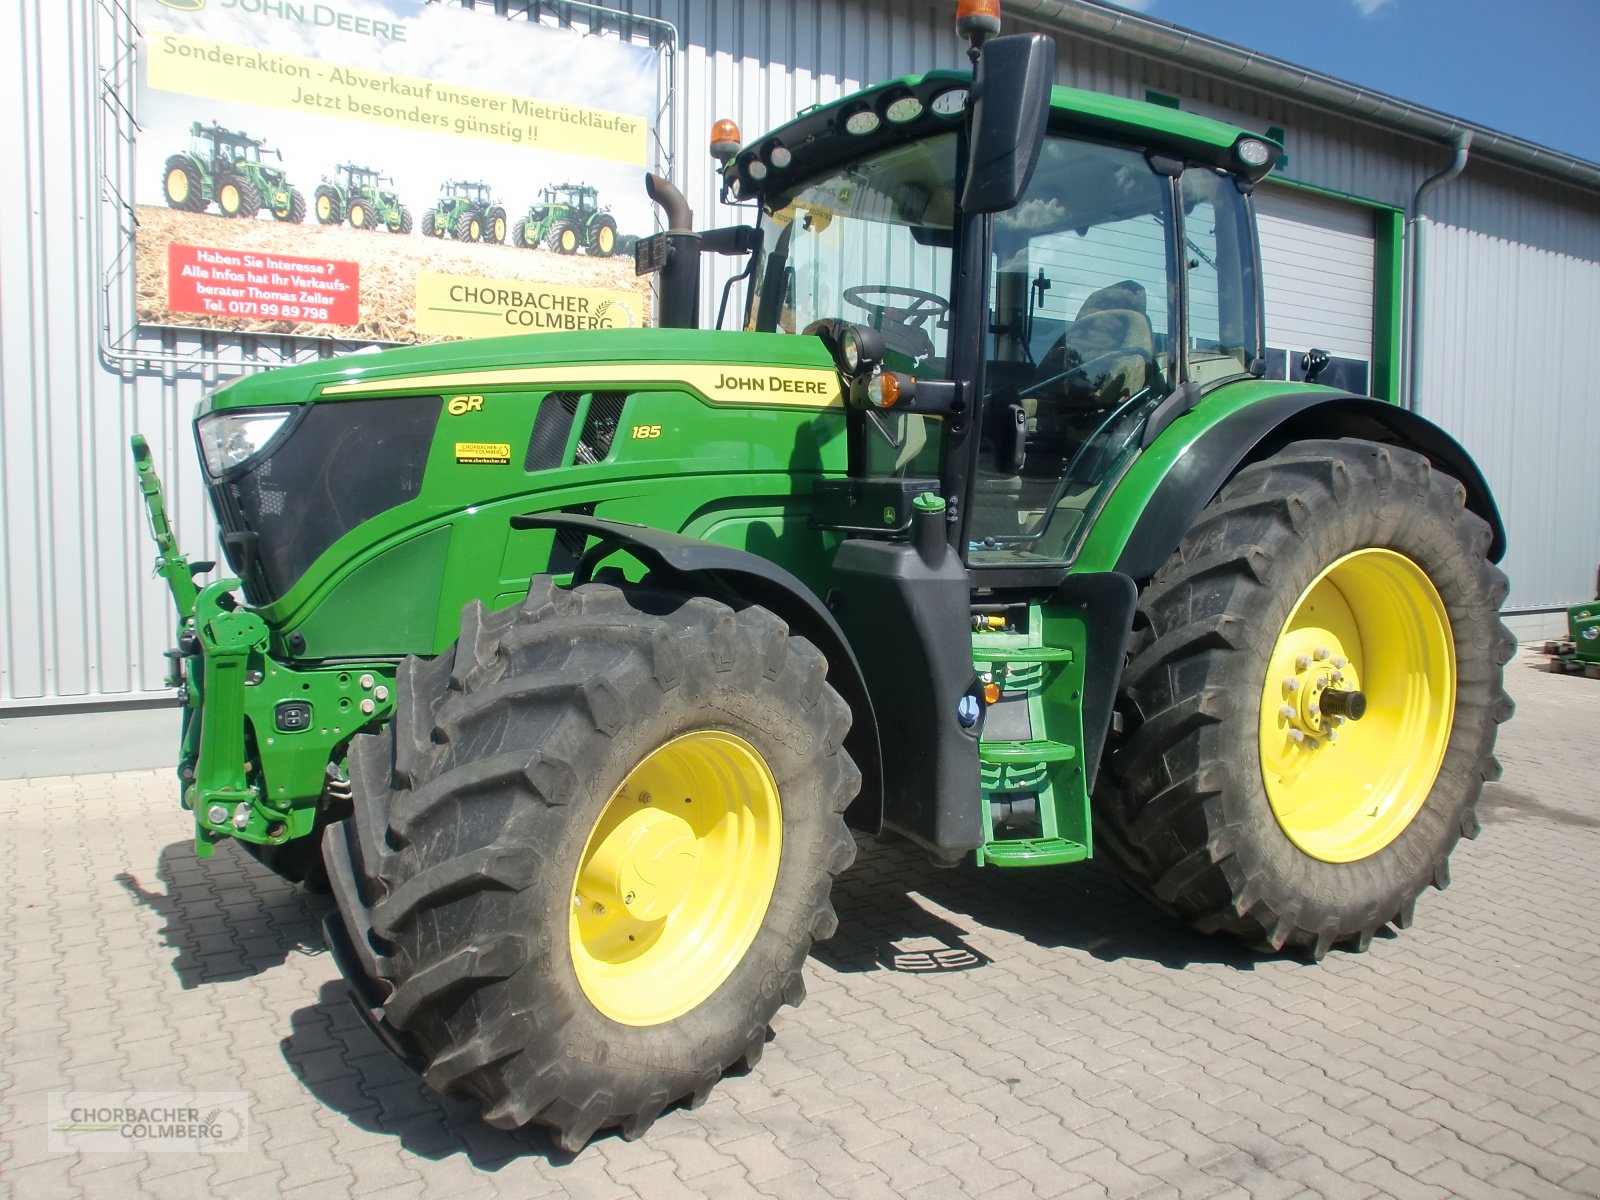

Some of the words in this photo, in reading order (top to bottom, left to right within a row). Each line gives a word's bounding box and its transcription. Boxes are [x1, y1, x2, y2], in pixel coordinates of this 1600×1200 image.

[314, 4, 407, 42] DEERE
[163, 36, 311, 79] Sonderaktion
[329, 67, 433, 98] Abverkauf
[436, 89, 507, 111] unserer
[511, 98, 637, 134] Mietrückläufer
[291, 86, 342, 110] Jetzt
[348, 95, 449, 127] besonders
[454, 115, 522, 142] günstig
[197, 250, 240, 266] Haben
[243, 255, 263, 268] Sie
[266, 257, 324, 274] Interesse
[181, 264, 209, 278] Alle
[212, 266, 245, 282] Infos
[247, 270, 268, 284] hat
[271, 272, 289, 286] Ihr
[290, 275, 350, 291] Verkaufs-
[196, 282, 244, 297] berater
[247, 286, 297, 302] Thomas
[299, 291, 335, 305] Zeller
[449, 285, 589, 313] CHORBACHER
[203, 298, 226, 312] Tel.
[228, 301, 257, 314] 0171
[259, 303, 279, 316] 99
[281, 305, 300, 318] 89
[302, 307, 328, 320] 798
[505, 309, 613, 330] COLMBERG
[714, 373, 765, 391] JOHN
[769, 376, 828, 395] DEERE
[448, 395, 484, 416] 6R
[631, 424, 662, 440] 185
